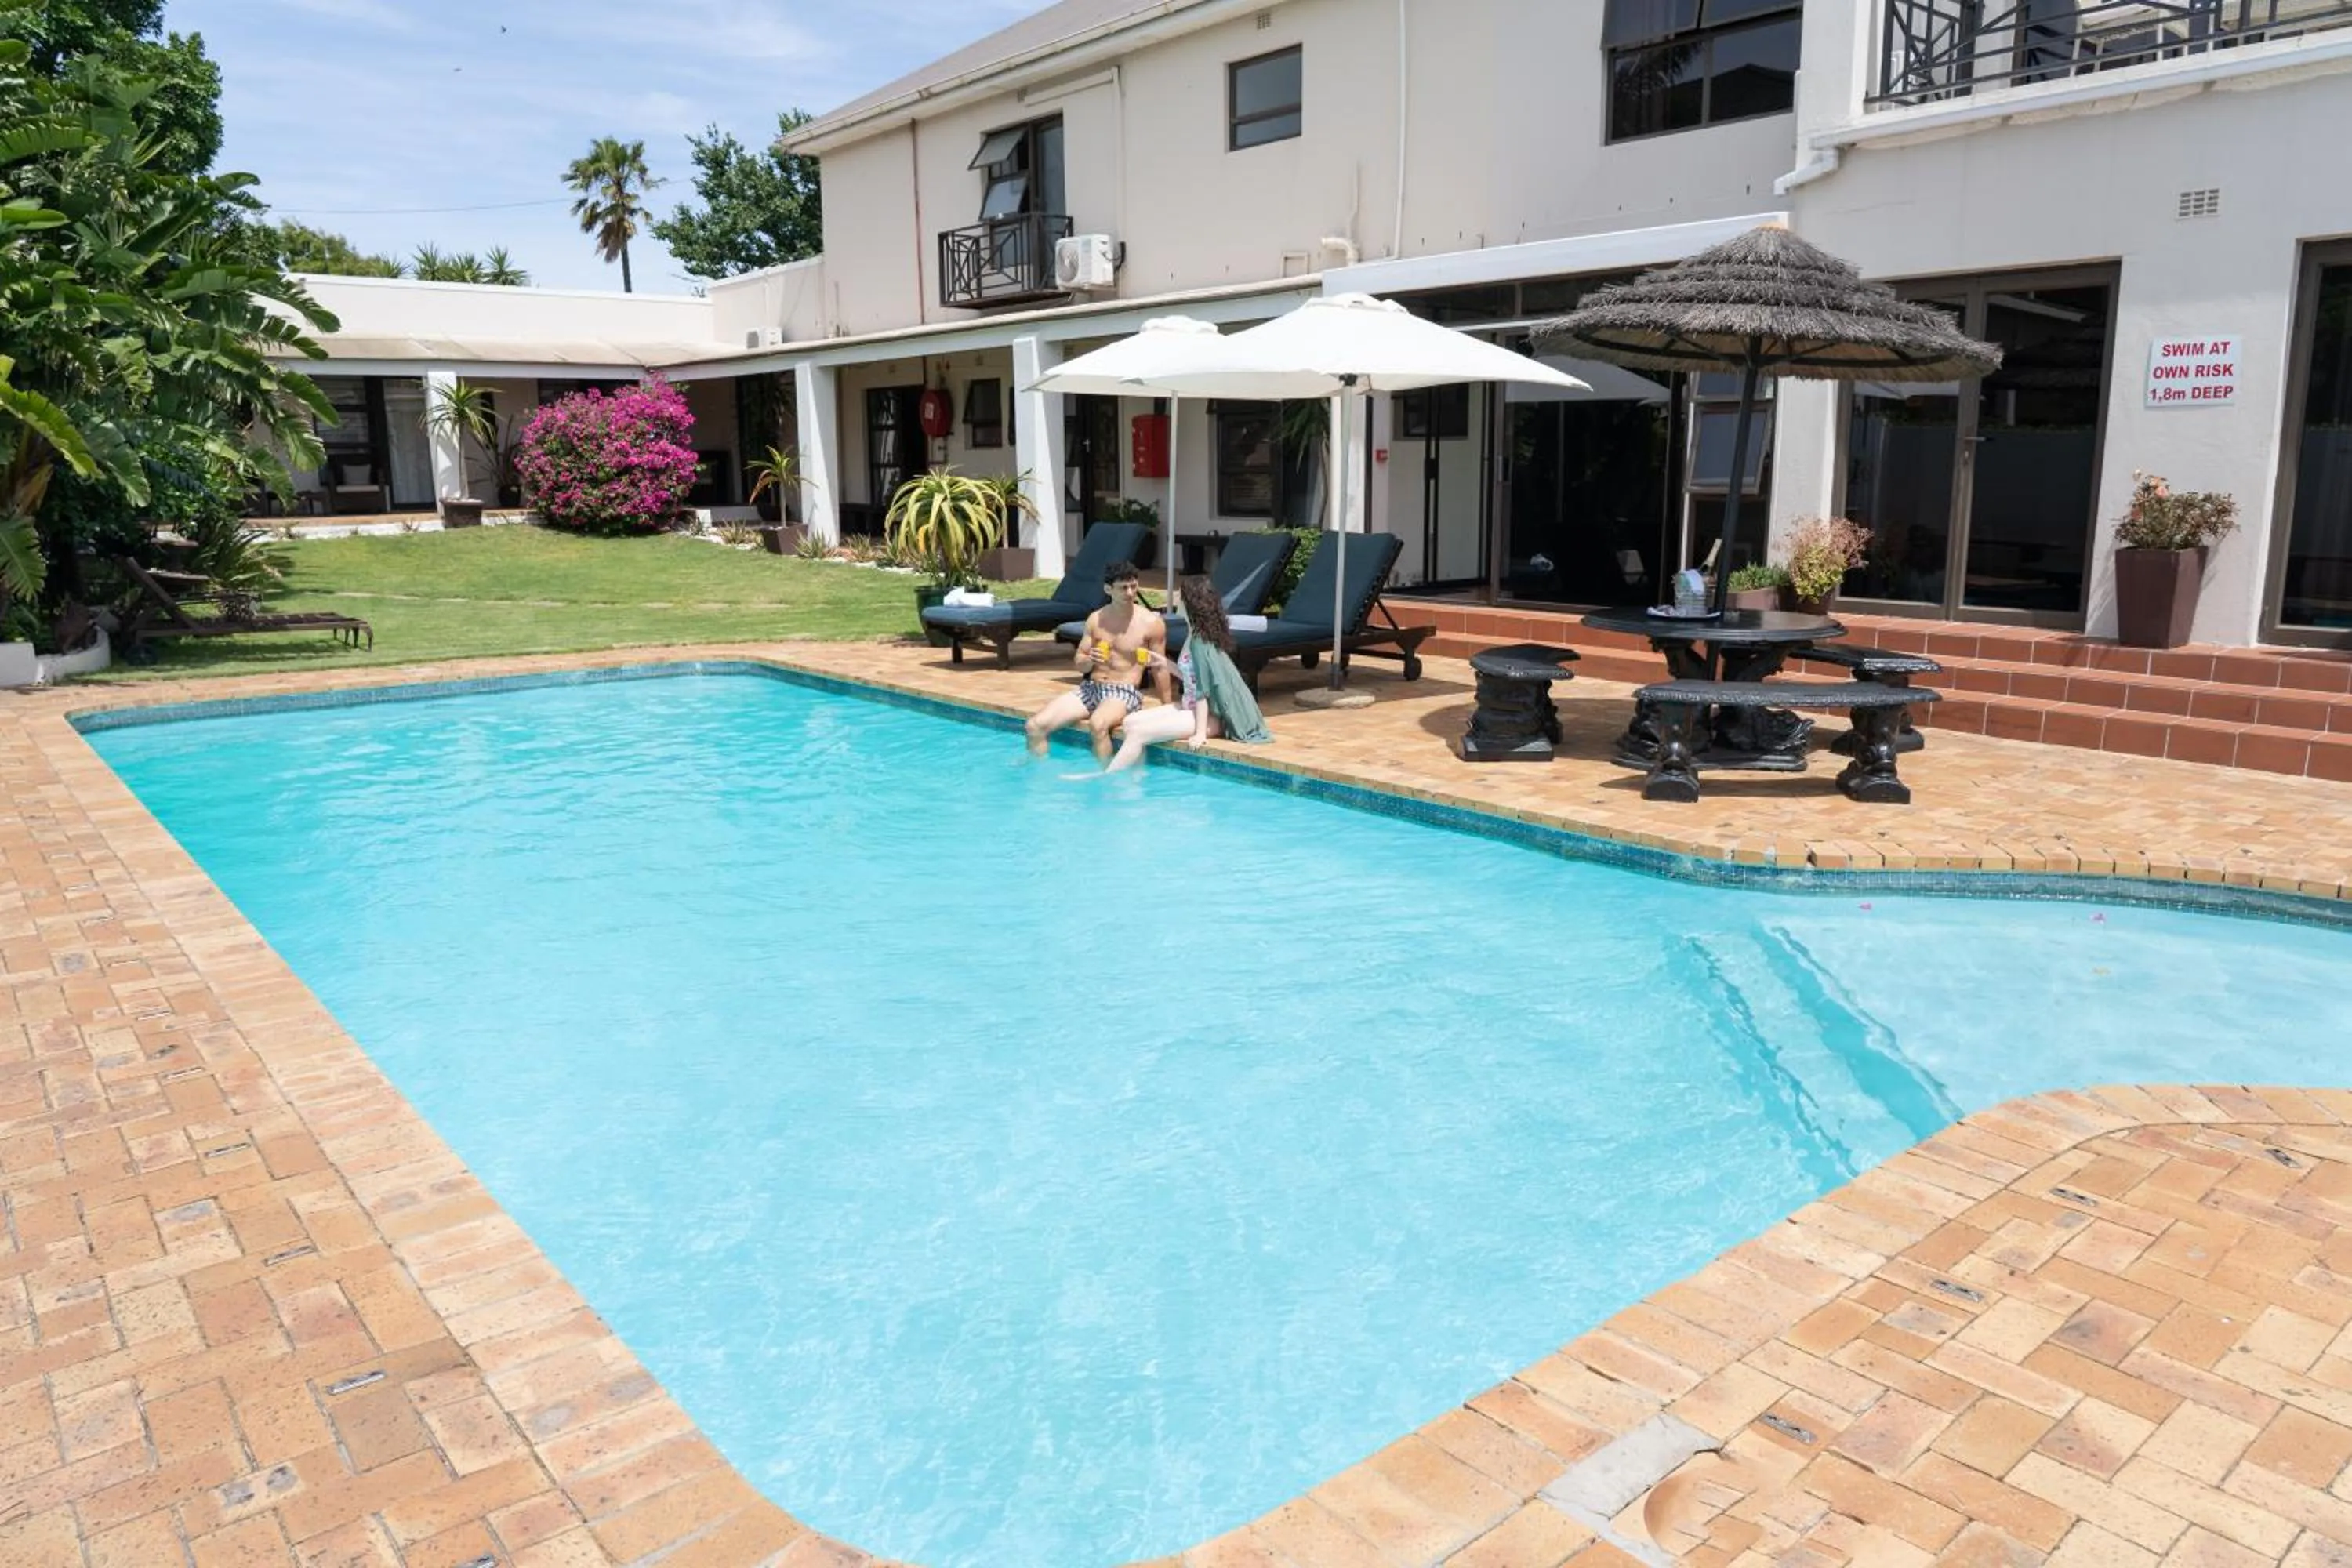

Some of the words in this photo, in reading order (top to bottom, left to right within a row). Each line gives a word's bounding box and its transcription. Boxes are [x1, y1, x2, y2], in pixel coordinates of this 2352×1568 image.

[2161, 343, 2205, 357] SWIM
[2209, 341, 2230, 355] AT
[2153, 365, 2189, 379] OWN
[2194, 363, 2234, 378] RISK
[2149, 387, 2186, 402] 1,8m
[2191, 386, 2234, 399] DEEP
